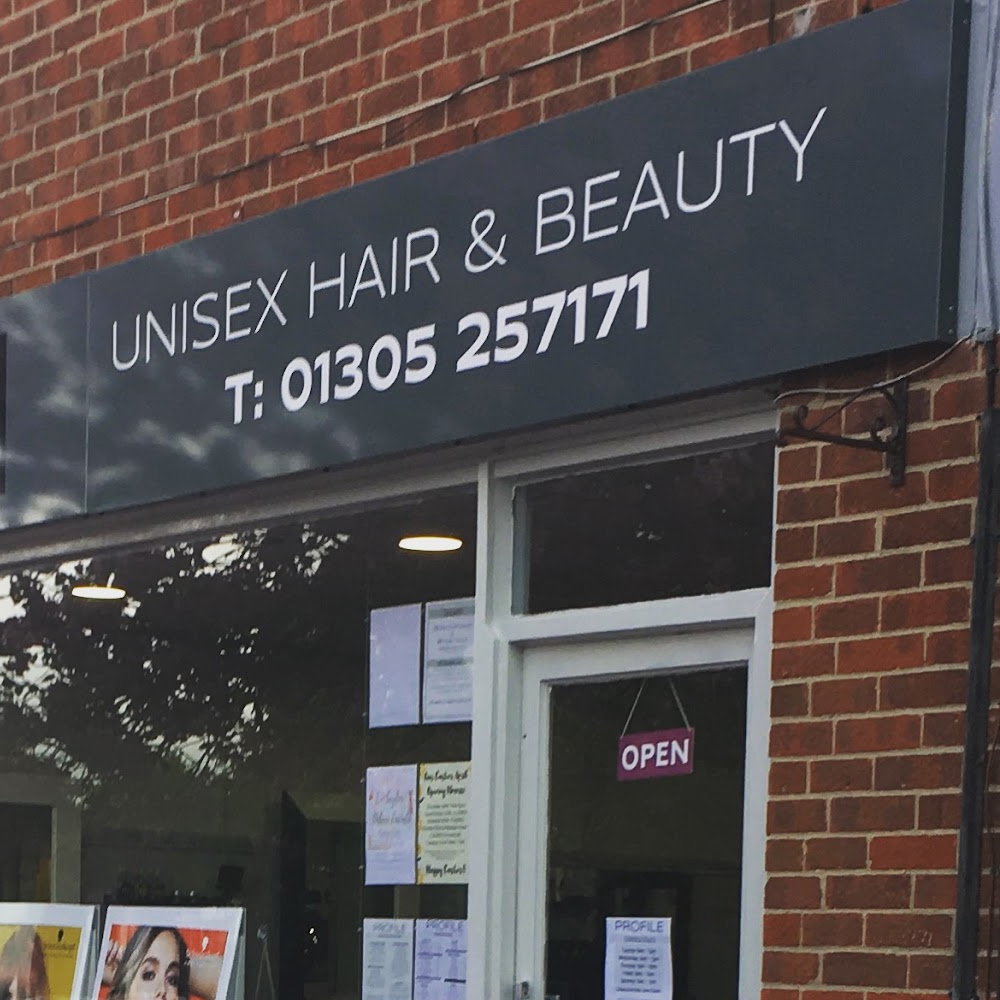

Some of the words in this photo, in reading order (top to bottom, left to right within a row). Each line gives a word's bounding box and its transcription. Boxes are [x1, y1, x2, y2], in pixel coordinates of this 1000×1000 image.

[112, 269, 288, 372] UNISEX
[308, 226, 440, 318] HAIR
[464, 208, 507, 273] &
[535, 106, 827, 255] BEAUTY
[224, 370, 264, 425] T:
[280, 323, 437, 412] 01305
[456, 268, 650, 373] 257171
[621, 738, 690, 771] OPEN
[614, 920, 664, 933] PROFILE
